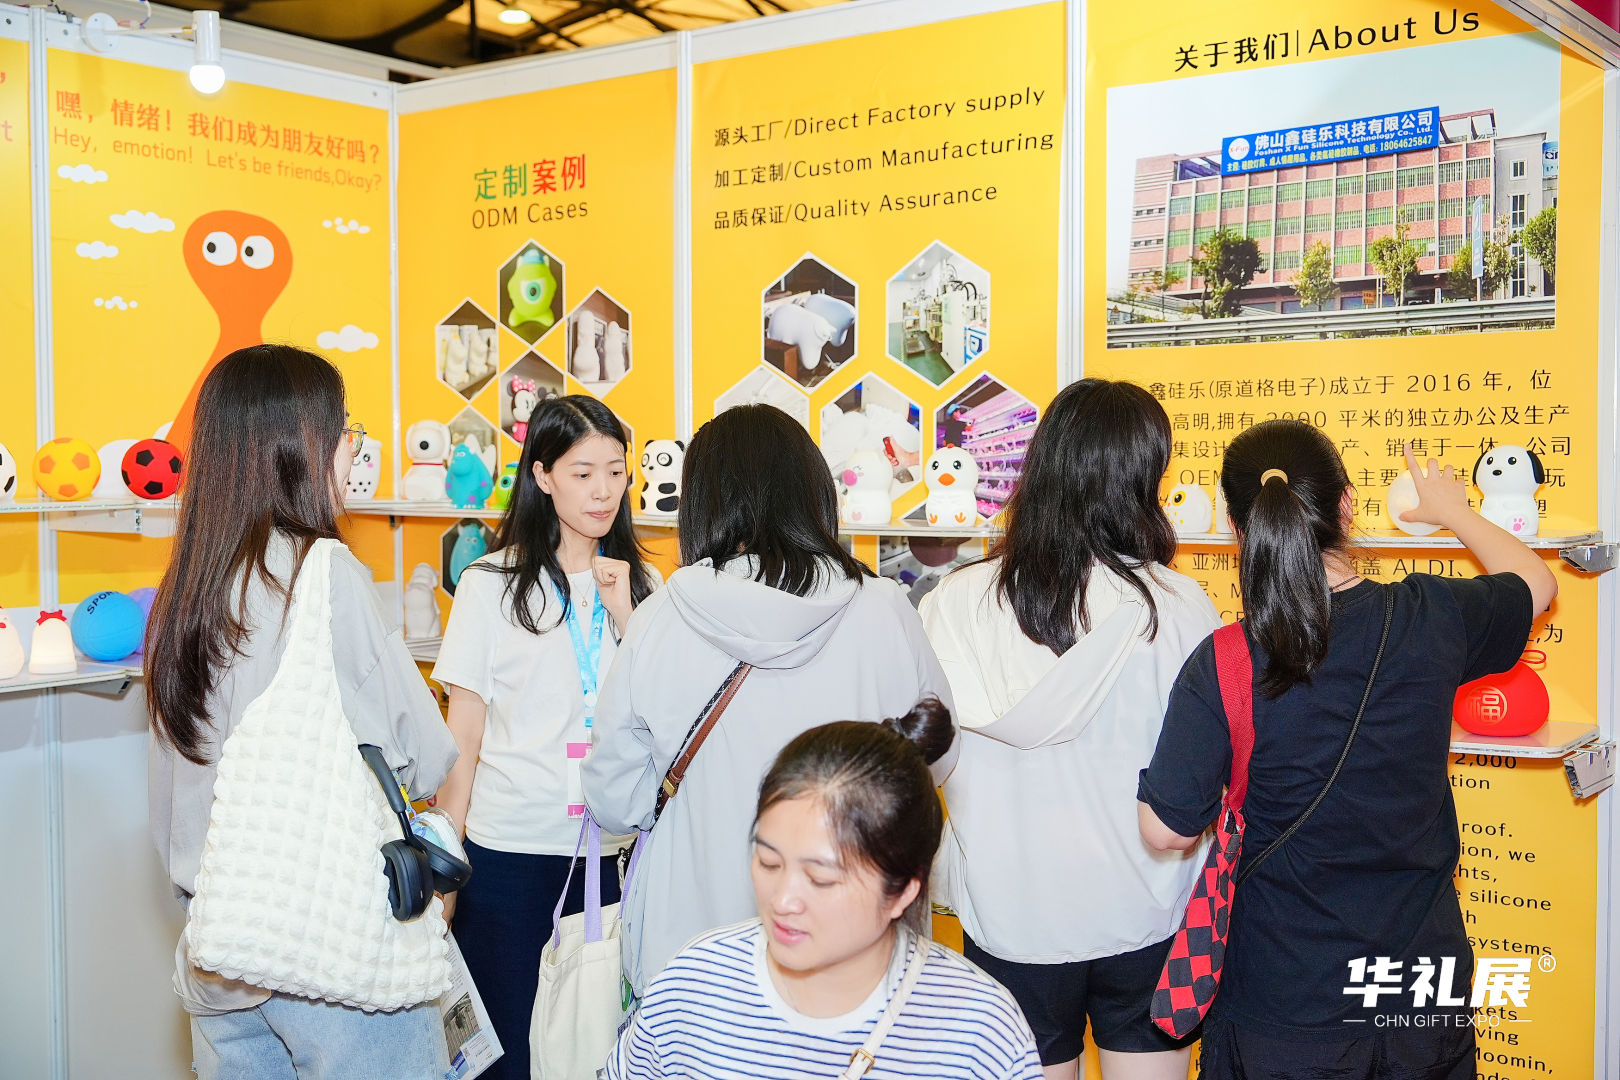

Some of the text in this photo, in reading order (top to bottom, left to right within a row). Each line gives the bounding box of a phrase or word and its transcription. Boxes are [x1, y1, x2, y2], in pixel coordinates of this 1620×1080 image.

[1308, 15, 1417, 54] About
[1434, 8, 1480, 36] Us
[868, 101, 956, 127] Factory
[966, 87, 1046, 112] supply
[1254, 110, 1433, 150] 佛山鑫硅乐科技有限公司
[53, 126, 98, 154] Hey,
[113, 138, 193, 164] emotion!
[206, 149, 247, 171] Let's
[252, 155, 272, 175] be
[881, 133, 1055, 168] Manufacturing
[1254, 148, 1283, 156] Foshan
[1293, 142, 1309, 151] Fun
[1311, 139, 1344, 149] Silicone
[1347, 131, 1396, 144] Technology
[473, 153, 586, 202] 定制案例
[878, 184, 998, 212] Assurance
[472, 201, 588, 230] ODM Cases
[1407, 373, 1471, 393] 2016
[1338, 404, 1570, 428] 平米的独立办公及生产
[1455, 752, 1517, 769] 2,000
[1462, 823, 1513, 838] roof.
[1508, 850, 1536, 863] we
[1452, 864, 1497, 883] hts,
[1470, 889, 1552, 911] silicone
